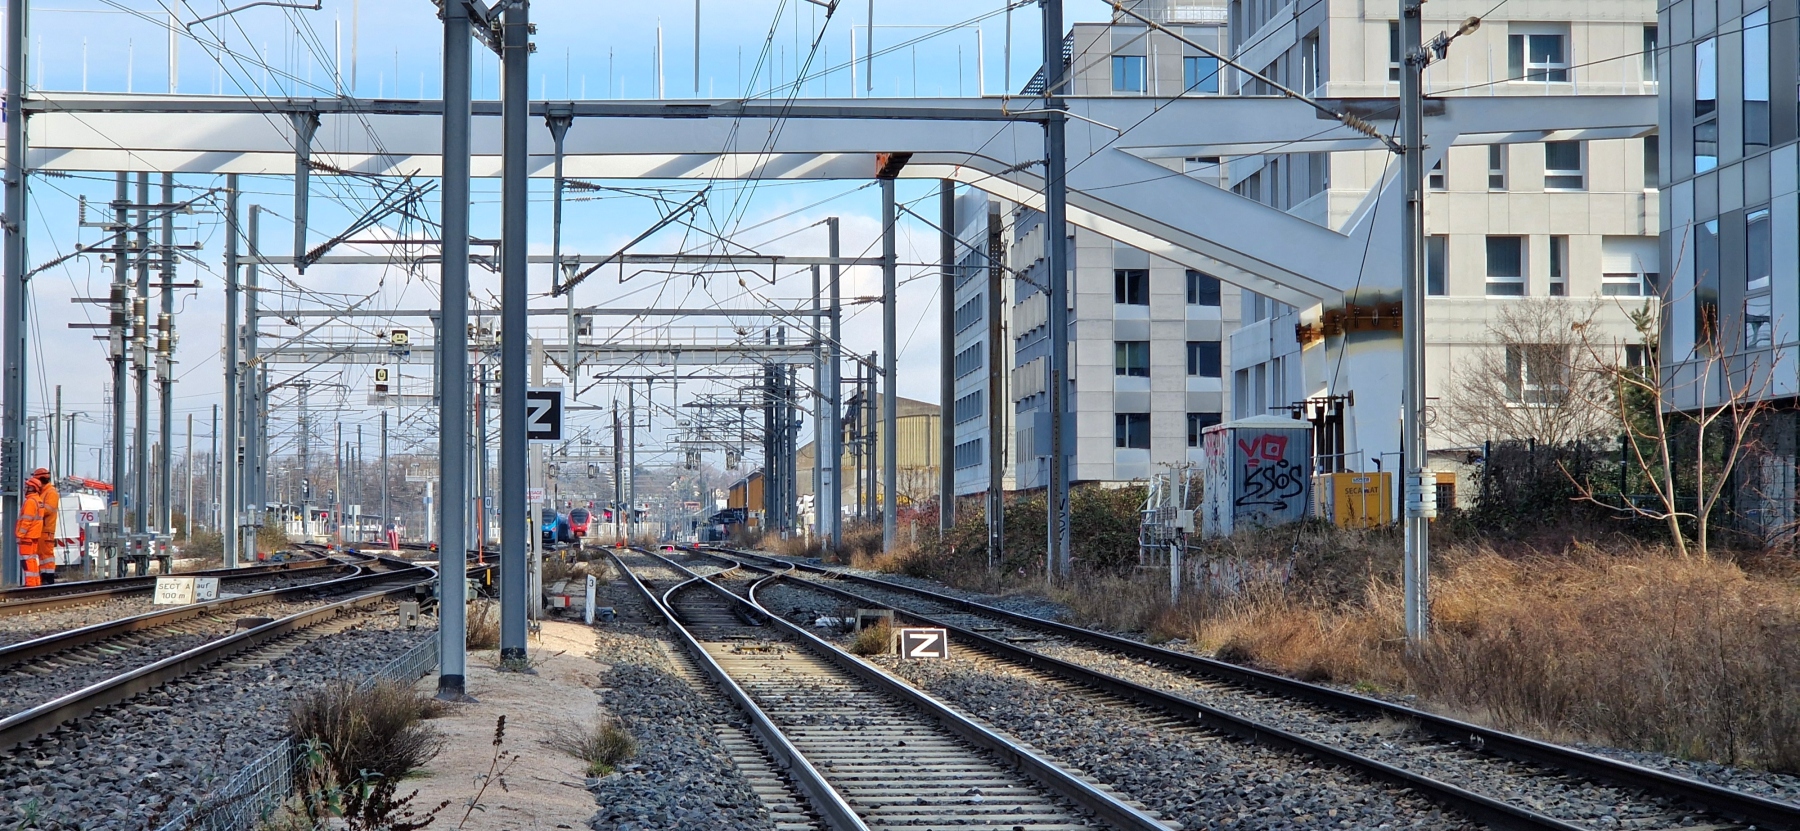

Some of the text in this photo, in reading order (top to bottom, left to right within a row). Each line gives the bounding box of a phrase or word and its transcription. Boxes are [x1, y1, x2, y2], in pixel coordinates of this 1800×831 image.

[527, 399, 552, 432] Z
[80, 512, 94, 521] 76
[589, 579, 594, 587] 3
[909, 633, 939, 657] Z
